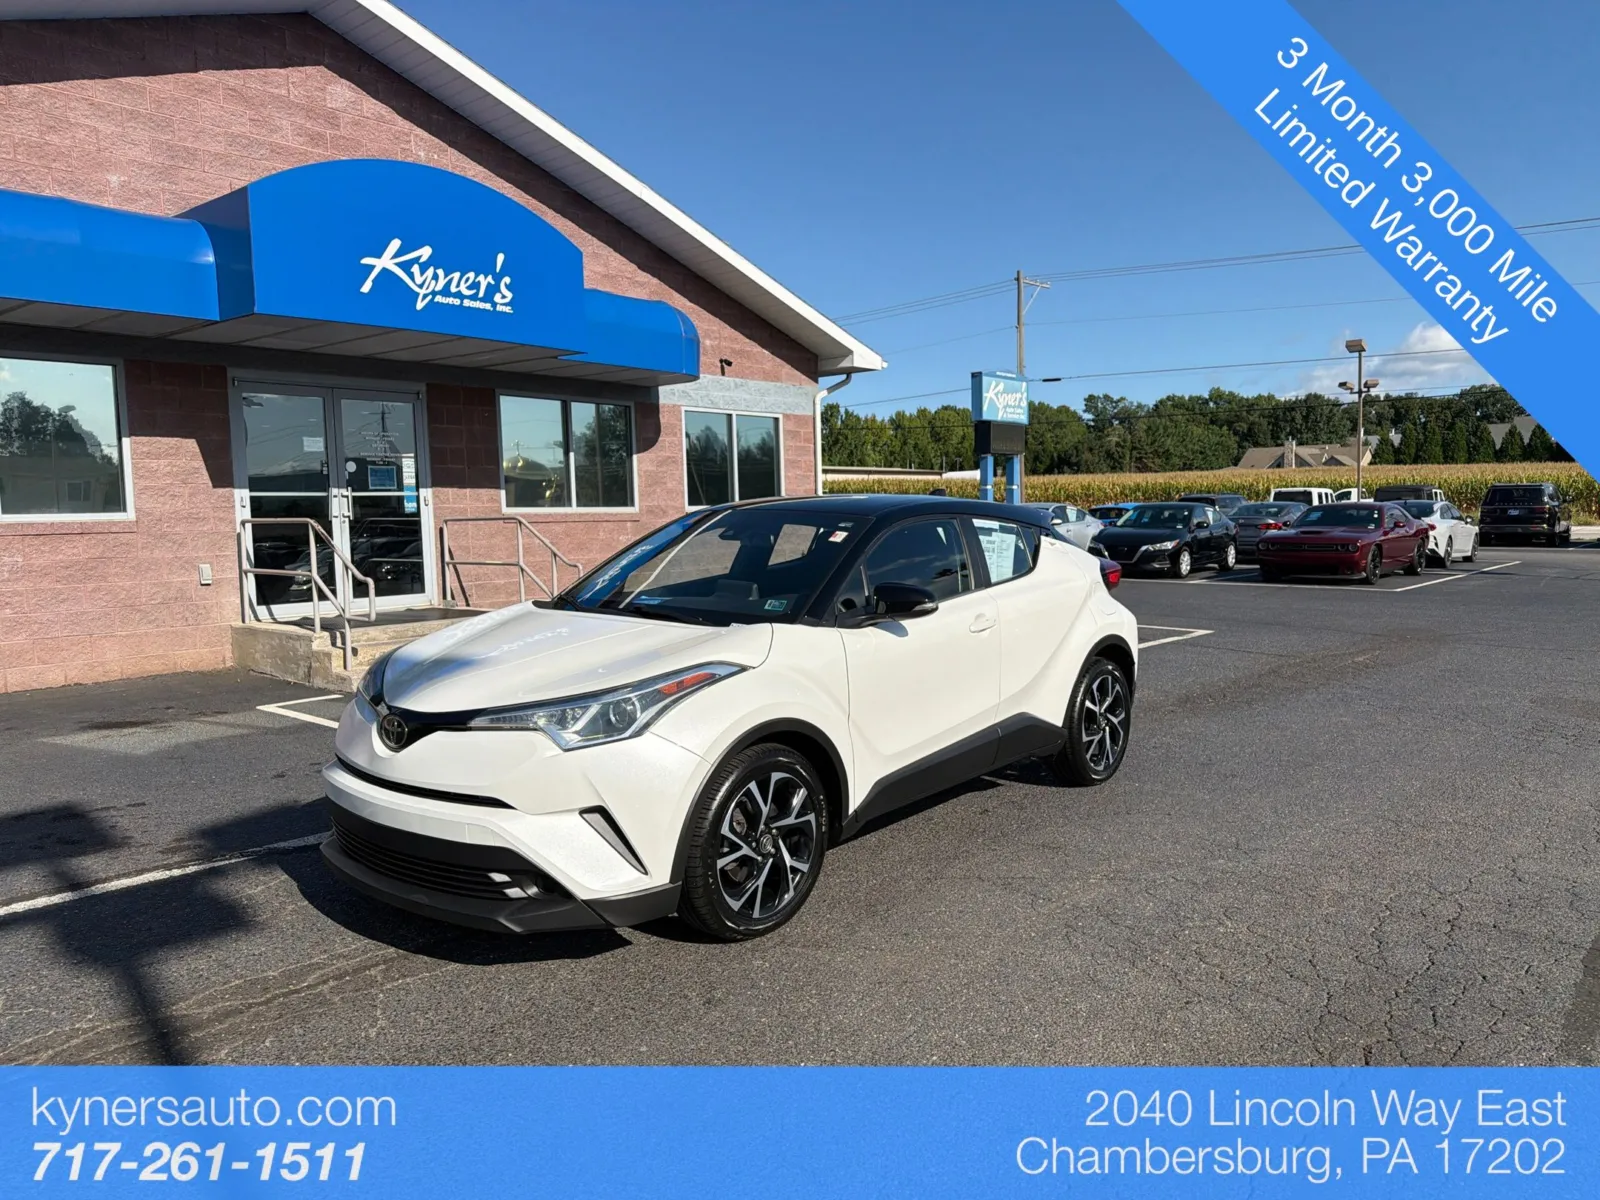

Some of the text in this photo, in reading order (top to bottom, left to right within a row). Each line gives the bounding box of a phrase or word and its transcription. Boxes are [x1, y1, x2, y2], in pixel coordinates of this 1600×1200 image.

[359, 238, 513, 311] Kyner's
[434, 294, 514, 313] Auto Sales, Inc.
[983, 380, 1027, 420] Kyner's
